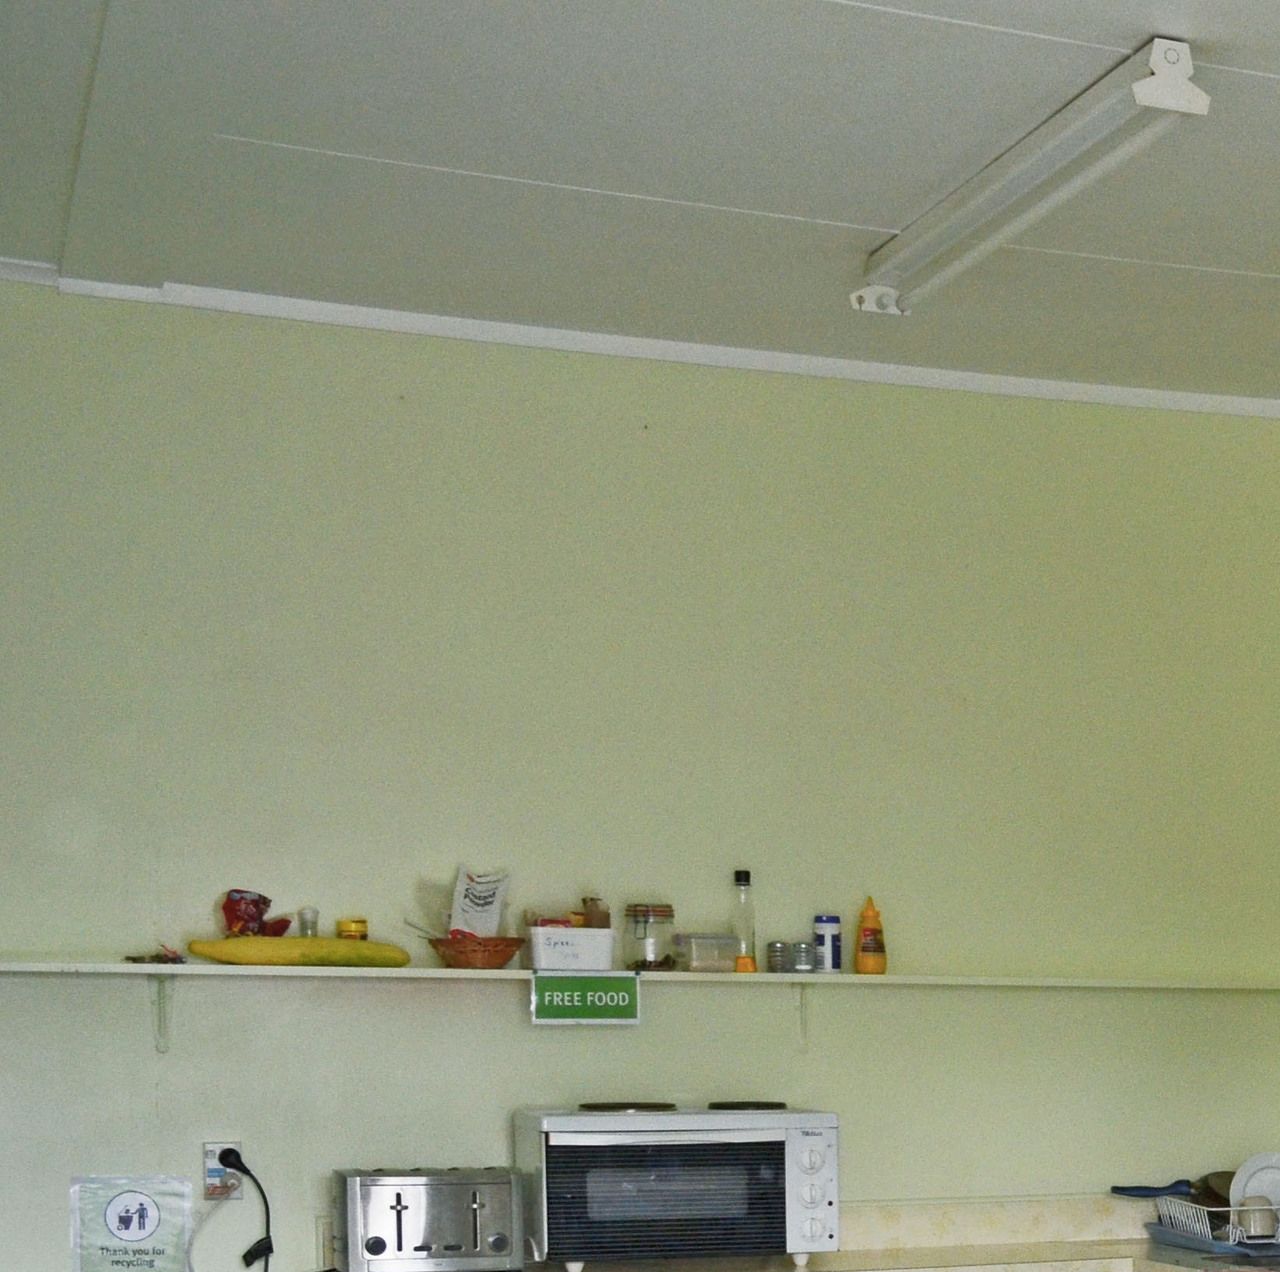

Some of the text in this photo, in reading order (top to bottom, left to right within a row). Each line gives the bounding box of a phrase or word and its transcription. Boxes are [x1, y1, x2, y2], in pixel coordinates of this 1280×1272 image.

[544, 991, 629, 1006] FREE FOOD
[99, 1246, 165, 1257] Thank you for
[111, 1257, 156, 1269] recycling
